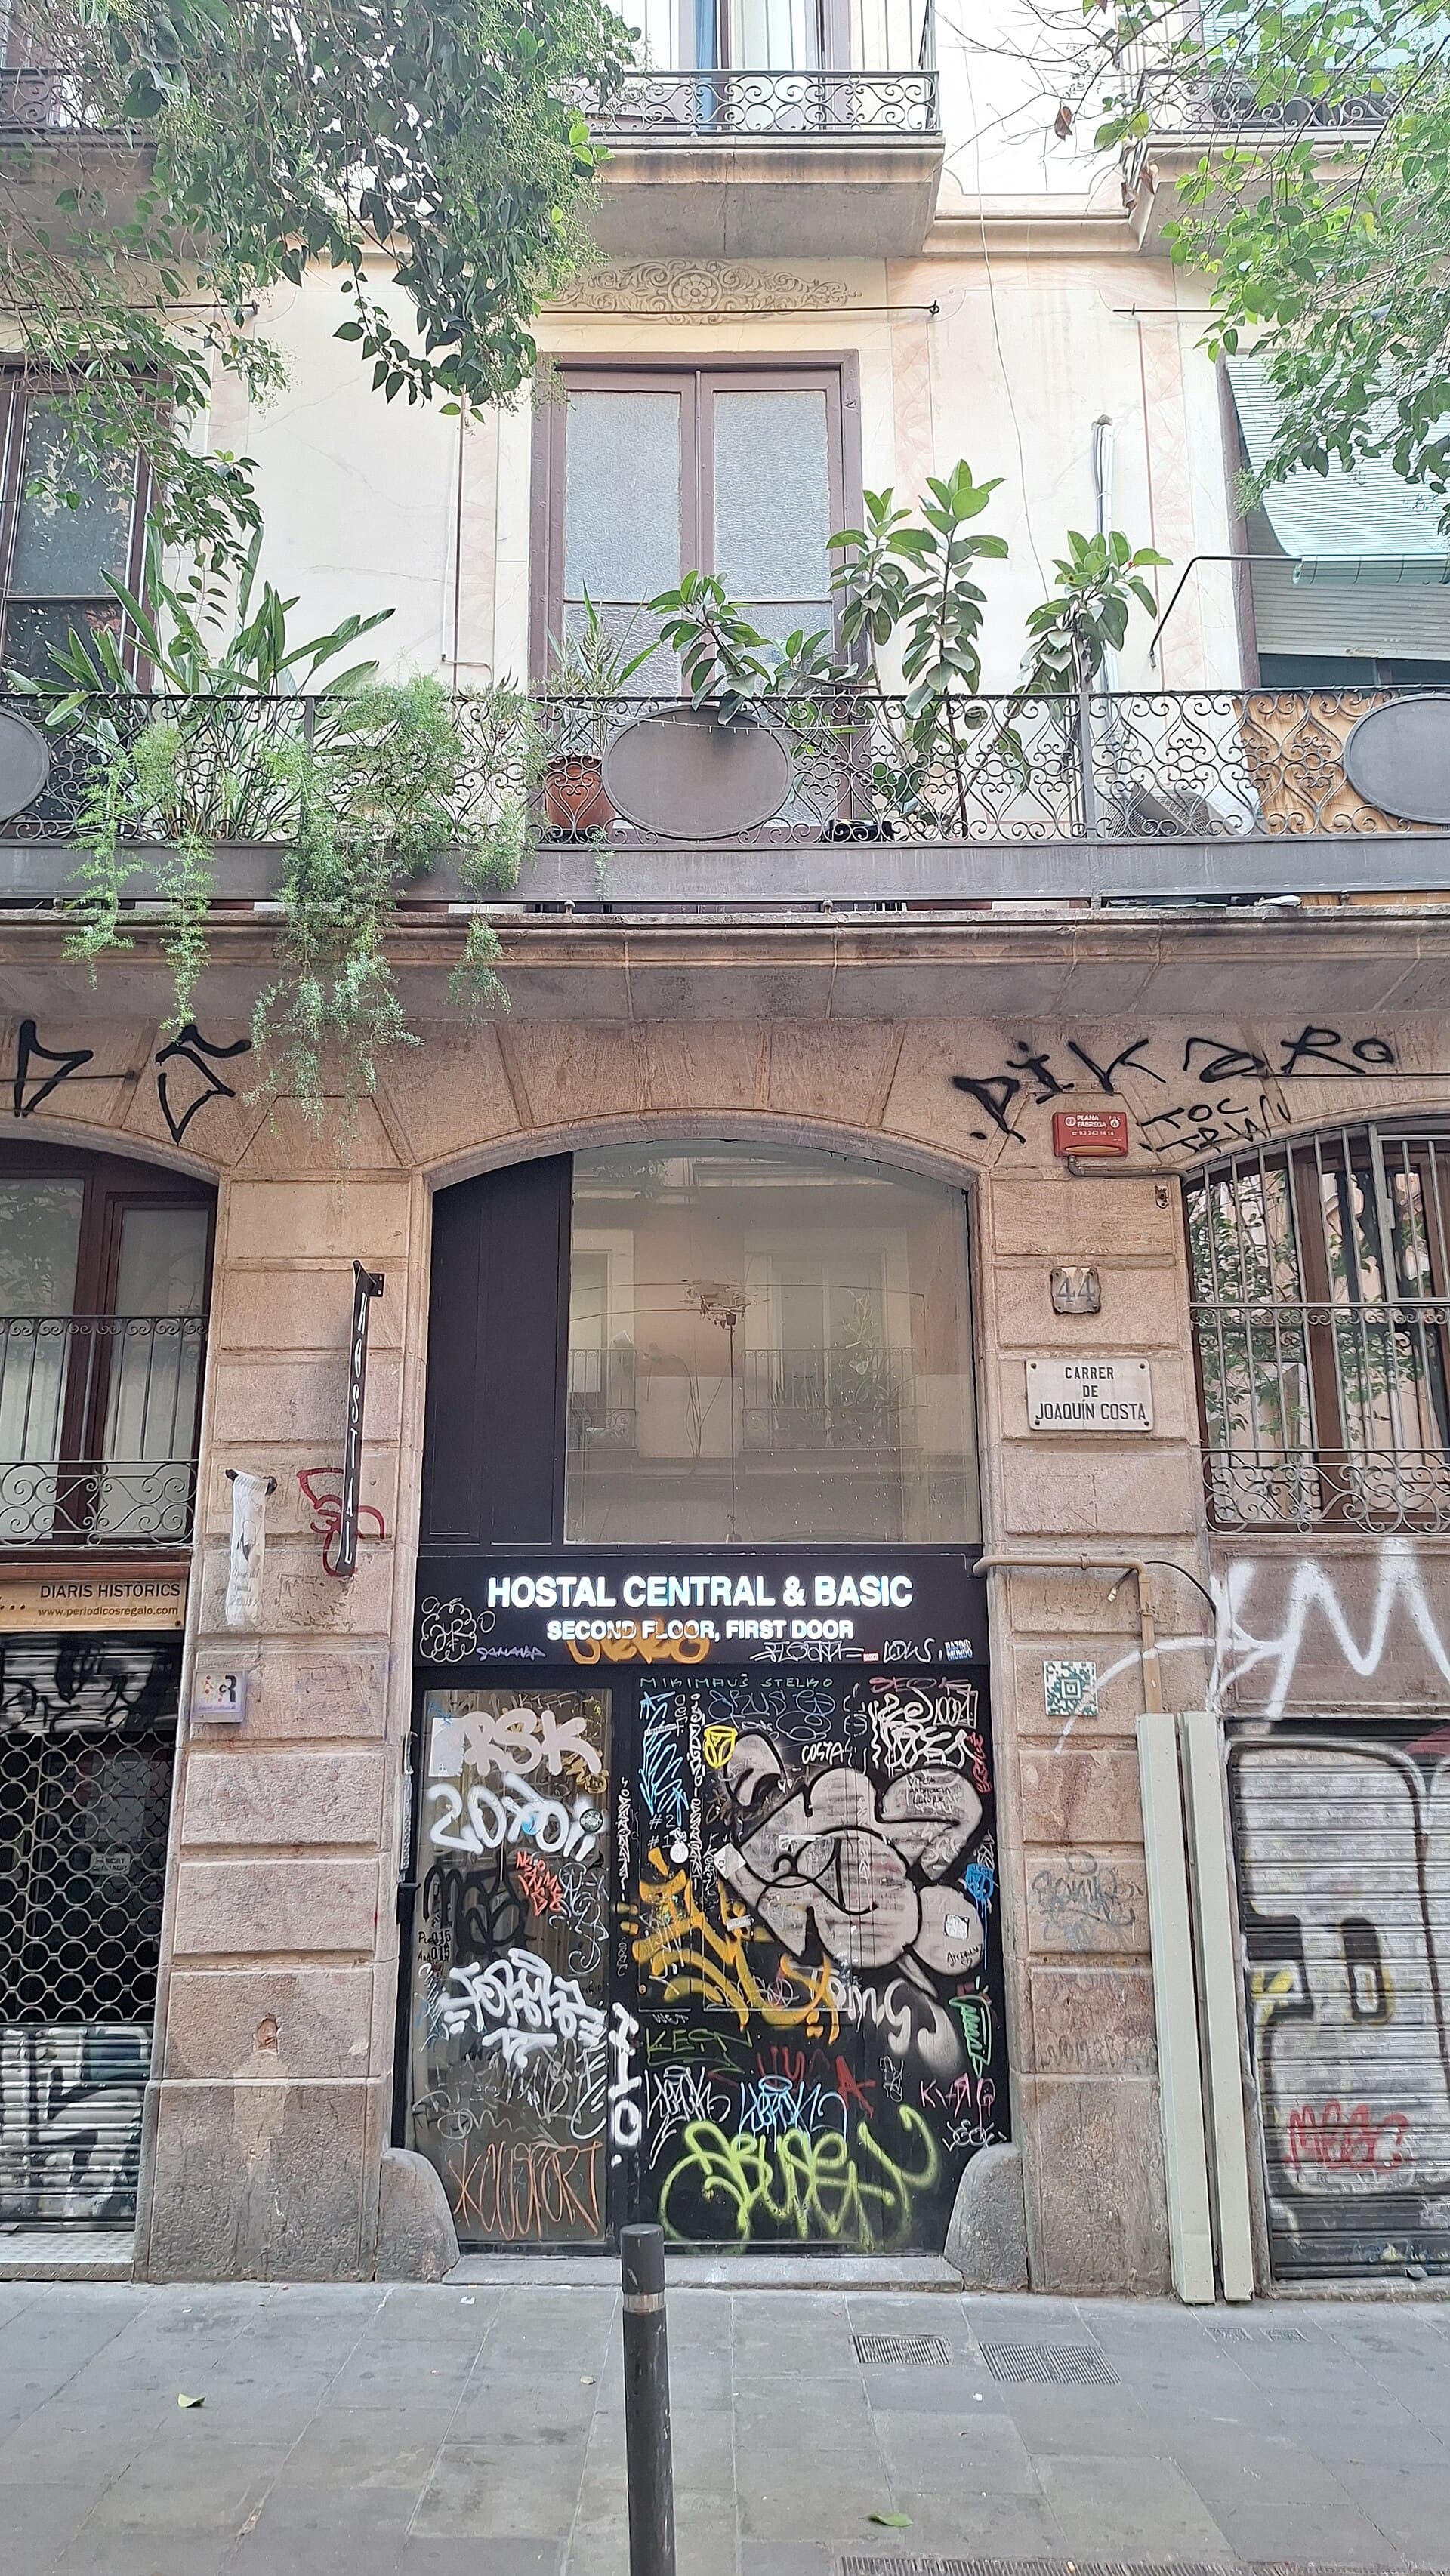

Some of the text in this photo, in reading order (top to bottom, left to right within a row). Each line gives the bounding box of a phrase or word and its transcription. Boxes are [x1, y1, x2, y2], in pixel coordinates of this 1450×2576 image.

[1056, 1277, 1097, 1303] 44
[1065, 1366, 1115, 1380] CARRER
[1083, 1384, 1099, 1398] DE
[1035, 1398, 1147, 1421] JOAQUÍN COSTA
[344, 1292, 367, 1565] HOSTAL
[40, 1582, 180, 1598] DIARIS HISTÒRICS
[487, 1575, 914, 1609] HOSTAL CENTRAL & BASIC
[39, 1606, 179, 1617] www.periodicosregalo.com
[546, 1619, 854, 1643] SECOND FLOOR, FIRST DOOR
[801, 1741, 846, 1765] COSTA
